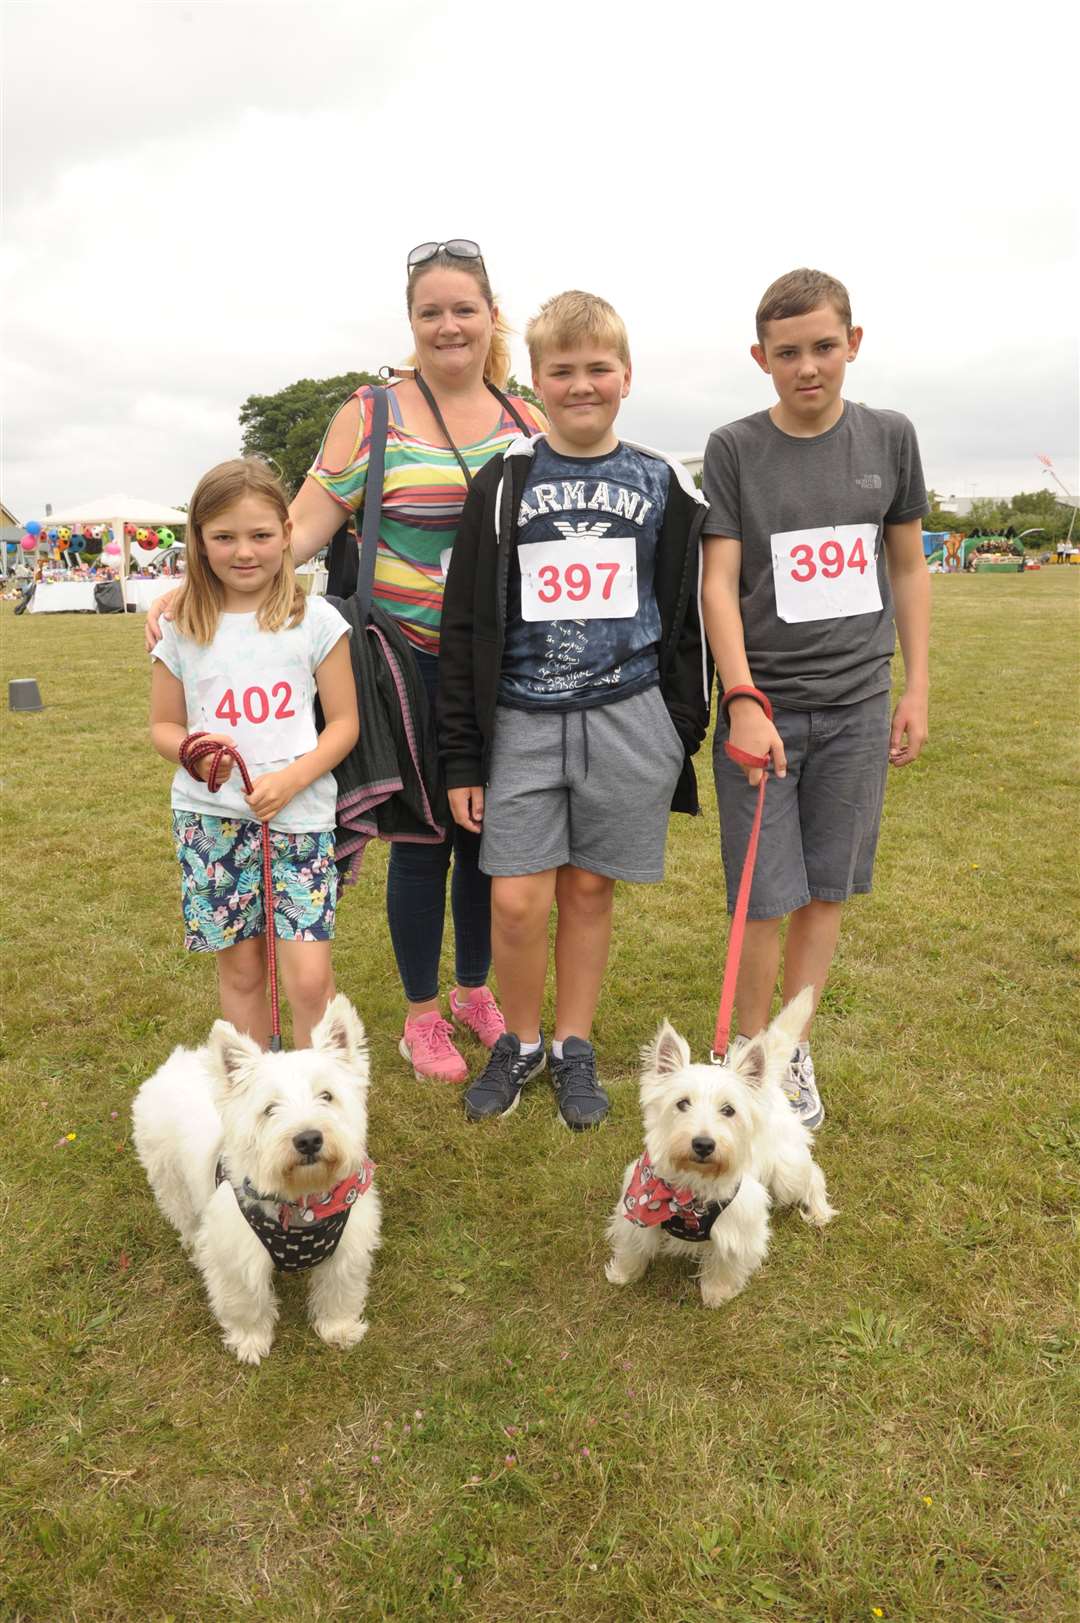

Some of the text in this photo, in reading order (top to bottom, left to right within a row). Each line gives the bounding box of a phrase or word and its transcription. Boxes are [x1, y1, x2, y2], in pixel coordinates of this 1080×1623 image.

[517, 481, 652, 525] ARMANI
[790, 538, 868, 582] 394
[539, 563, 620, 603] 397
[215, 681, 295, 727] 402
